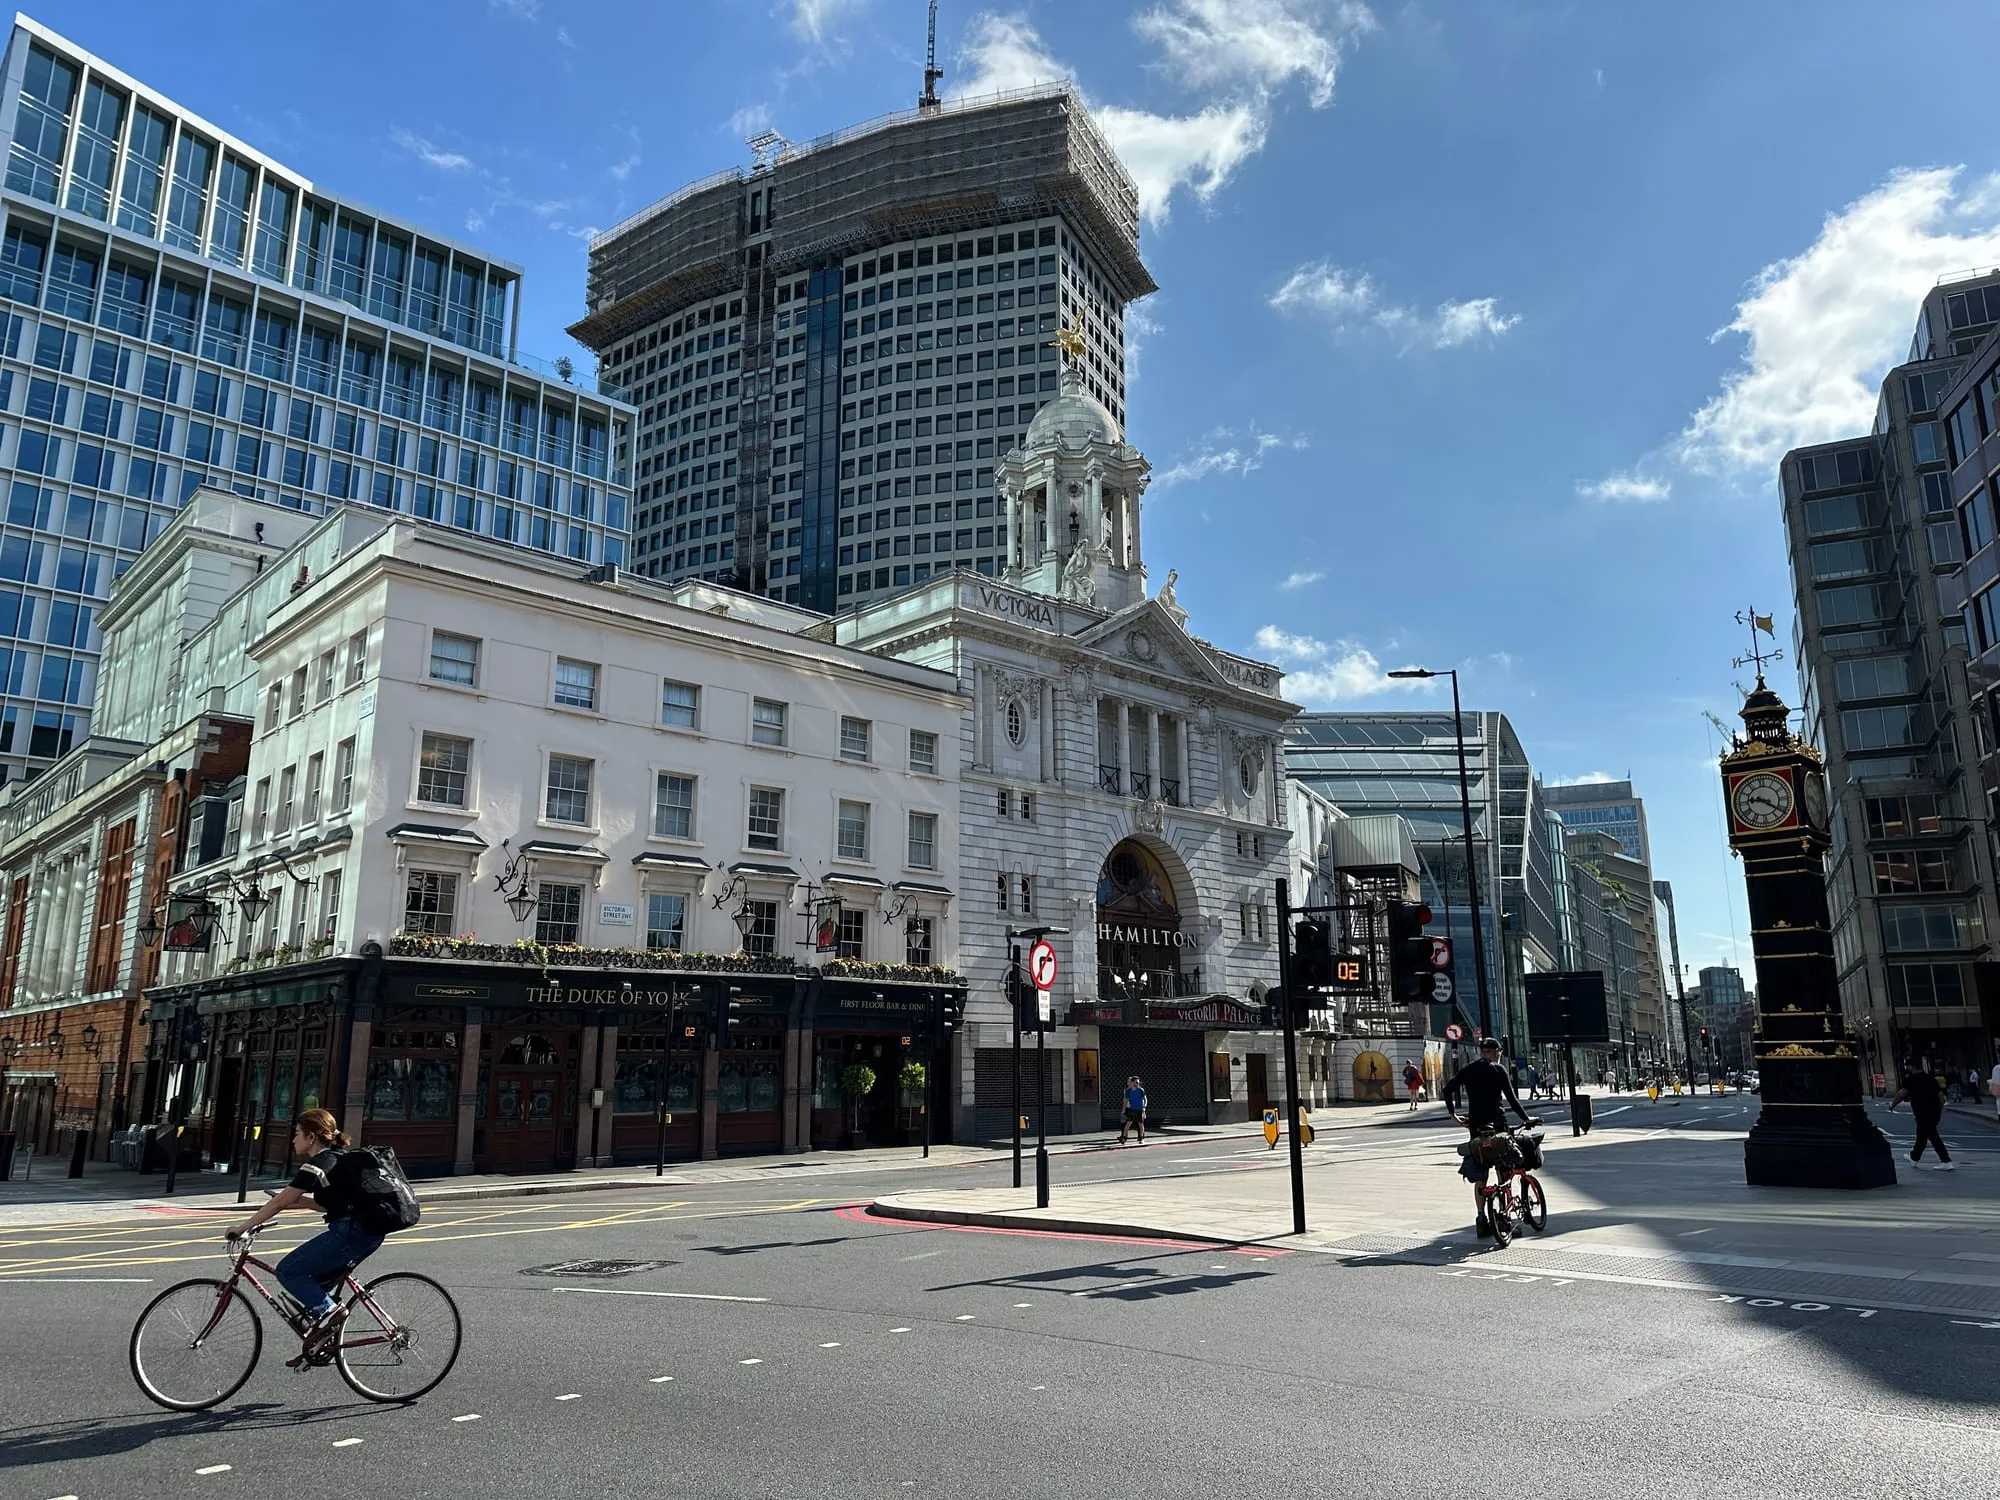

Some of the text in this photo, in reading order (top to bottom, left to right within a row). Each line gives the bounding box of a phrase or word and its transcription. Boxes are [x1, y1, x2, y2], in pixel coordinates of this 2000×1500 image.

[980, 587, 1054, 626] VICTORIA
[1220, 659, 1270, 689] PALACE
[603, 905, 626, 913] VICTORIA
[1098, 923, 1197, 949] HAMILTON
[1338, 961, 1360, 981] 02
[526, 987, 564, 1003] THE
[567, 989, 617, 1004] DUKE
[620, 990, 643, 1005] OF
[840, 999, 860, 1008] FIRST
[861, 1000, 885, 1009] FLOOR
[886, 1001, 900, 1010] BAR
[1177, 1002, 1218, 1021] VICTORIA
[1223, 1003, 1262, 1024] PALACE
[684, 1026, 696, 1037] 02
[901, 1036, 911, 1045] 02
[1436, 1270, 1879, 1318] LOOK LEFT
